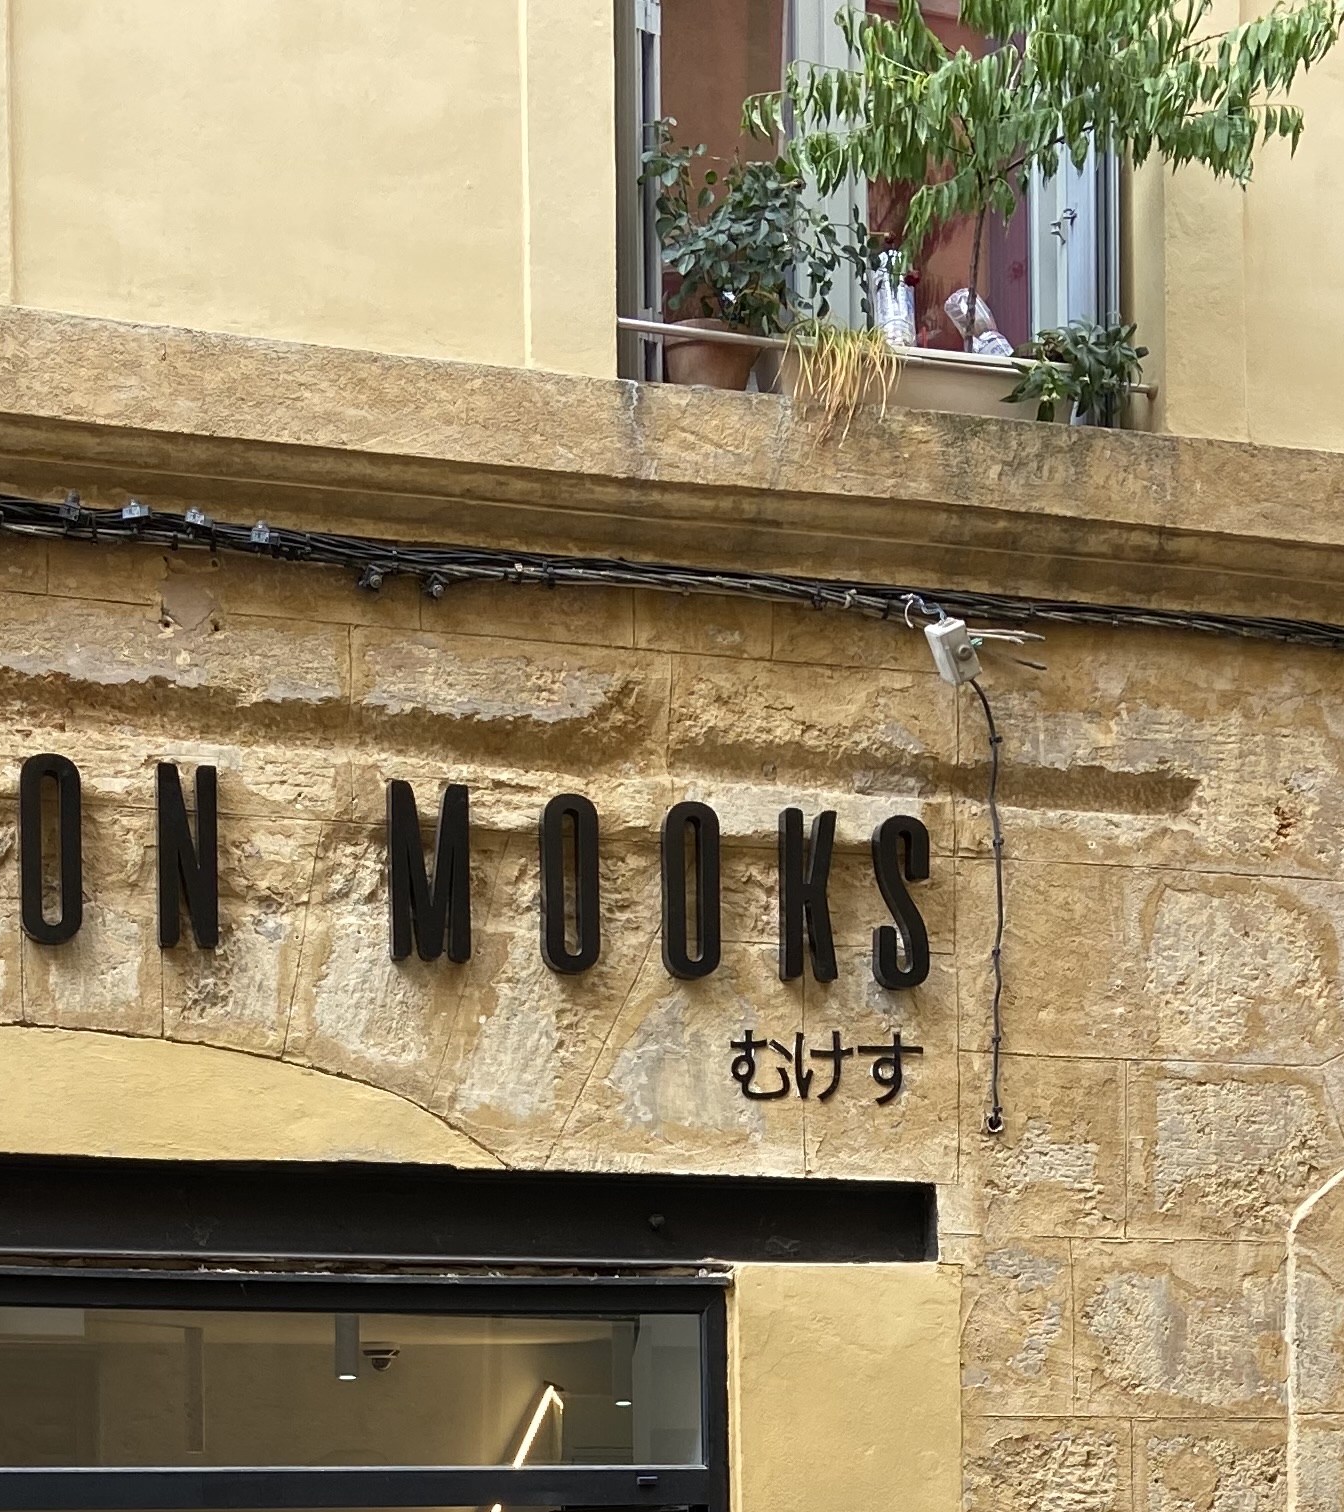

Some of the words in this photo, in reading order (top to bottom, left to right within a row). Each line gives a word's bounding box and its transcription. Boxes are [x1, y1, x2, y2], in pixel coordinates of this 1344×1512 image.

[386, 779, 930, 990] MOOKS
[730, 1030, 924, 1106] むけす
